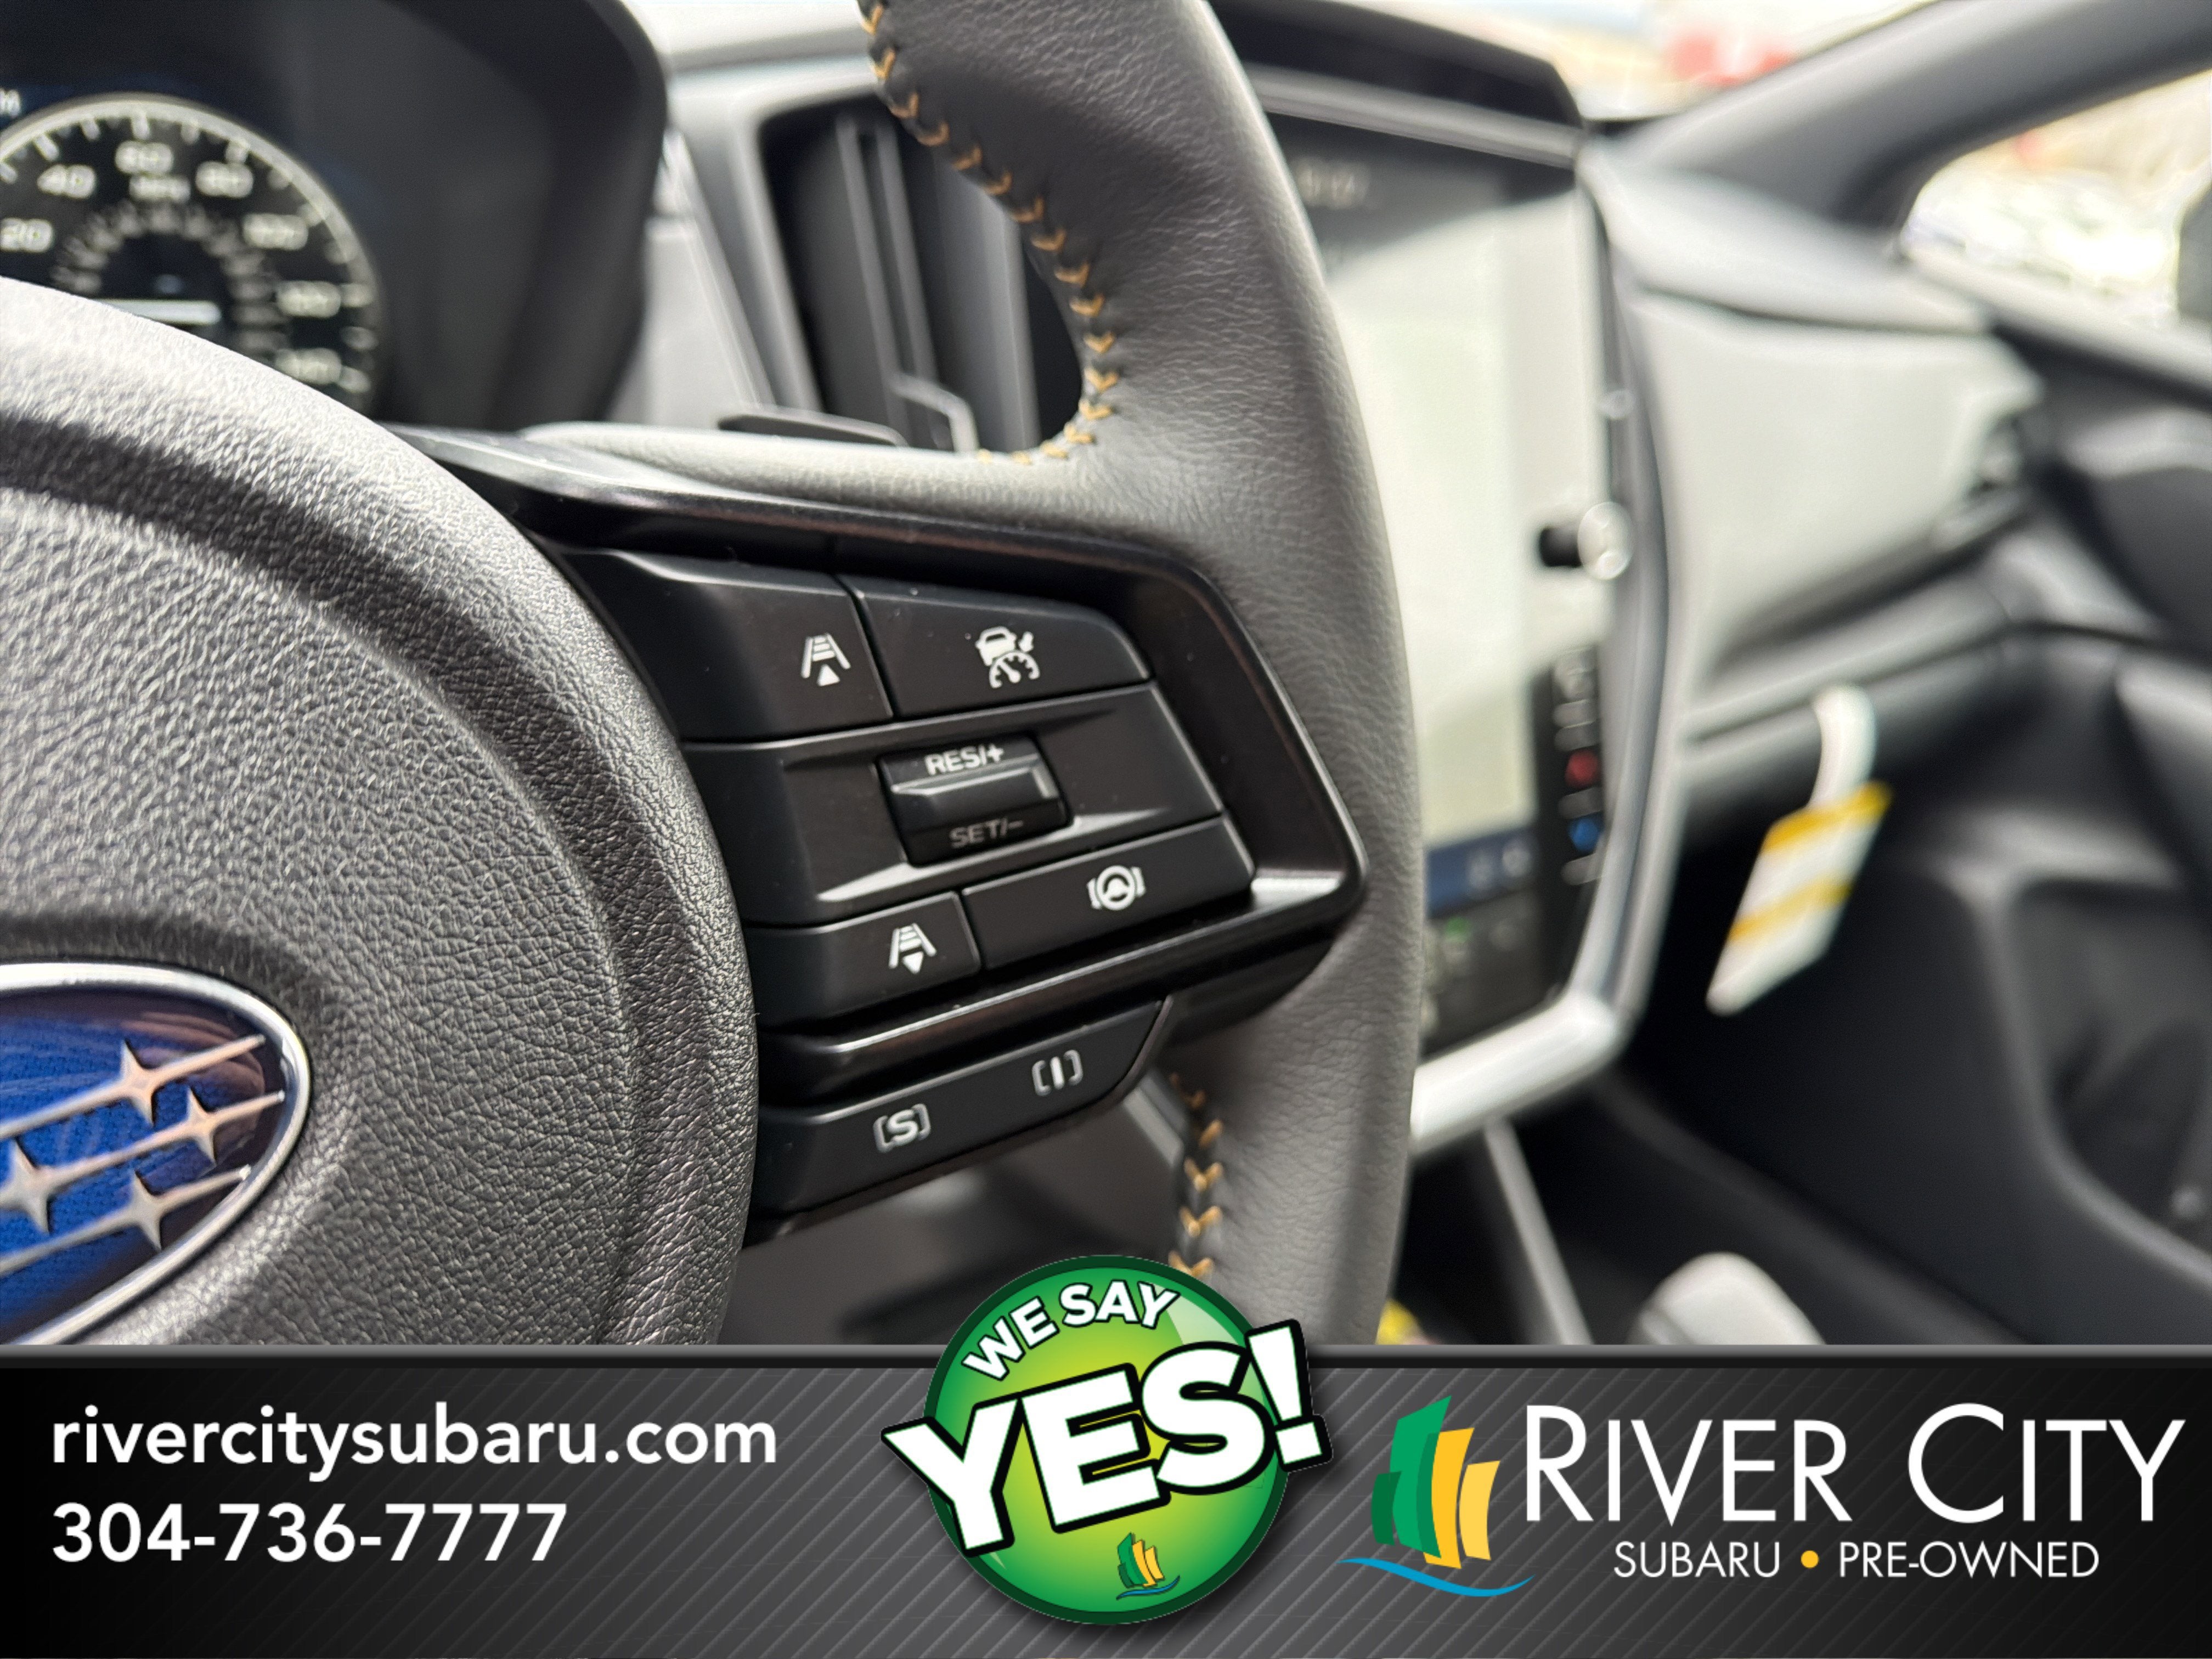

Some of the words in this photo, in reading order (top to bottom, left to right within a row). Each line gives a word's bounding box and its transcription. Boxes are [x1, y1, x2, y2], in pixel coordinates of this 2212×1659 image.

[37, 165, 95, 198] 40
[924, 743, 1005, 776] RES/+
[948, 817, 1024, 849] SET/-
